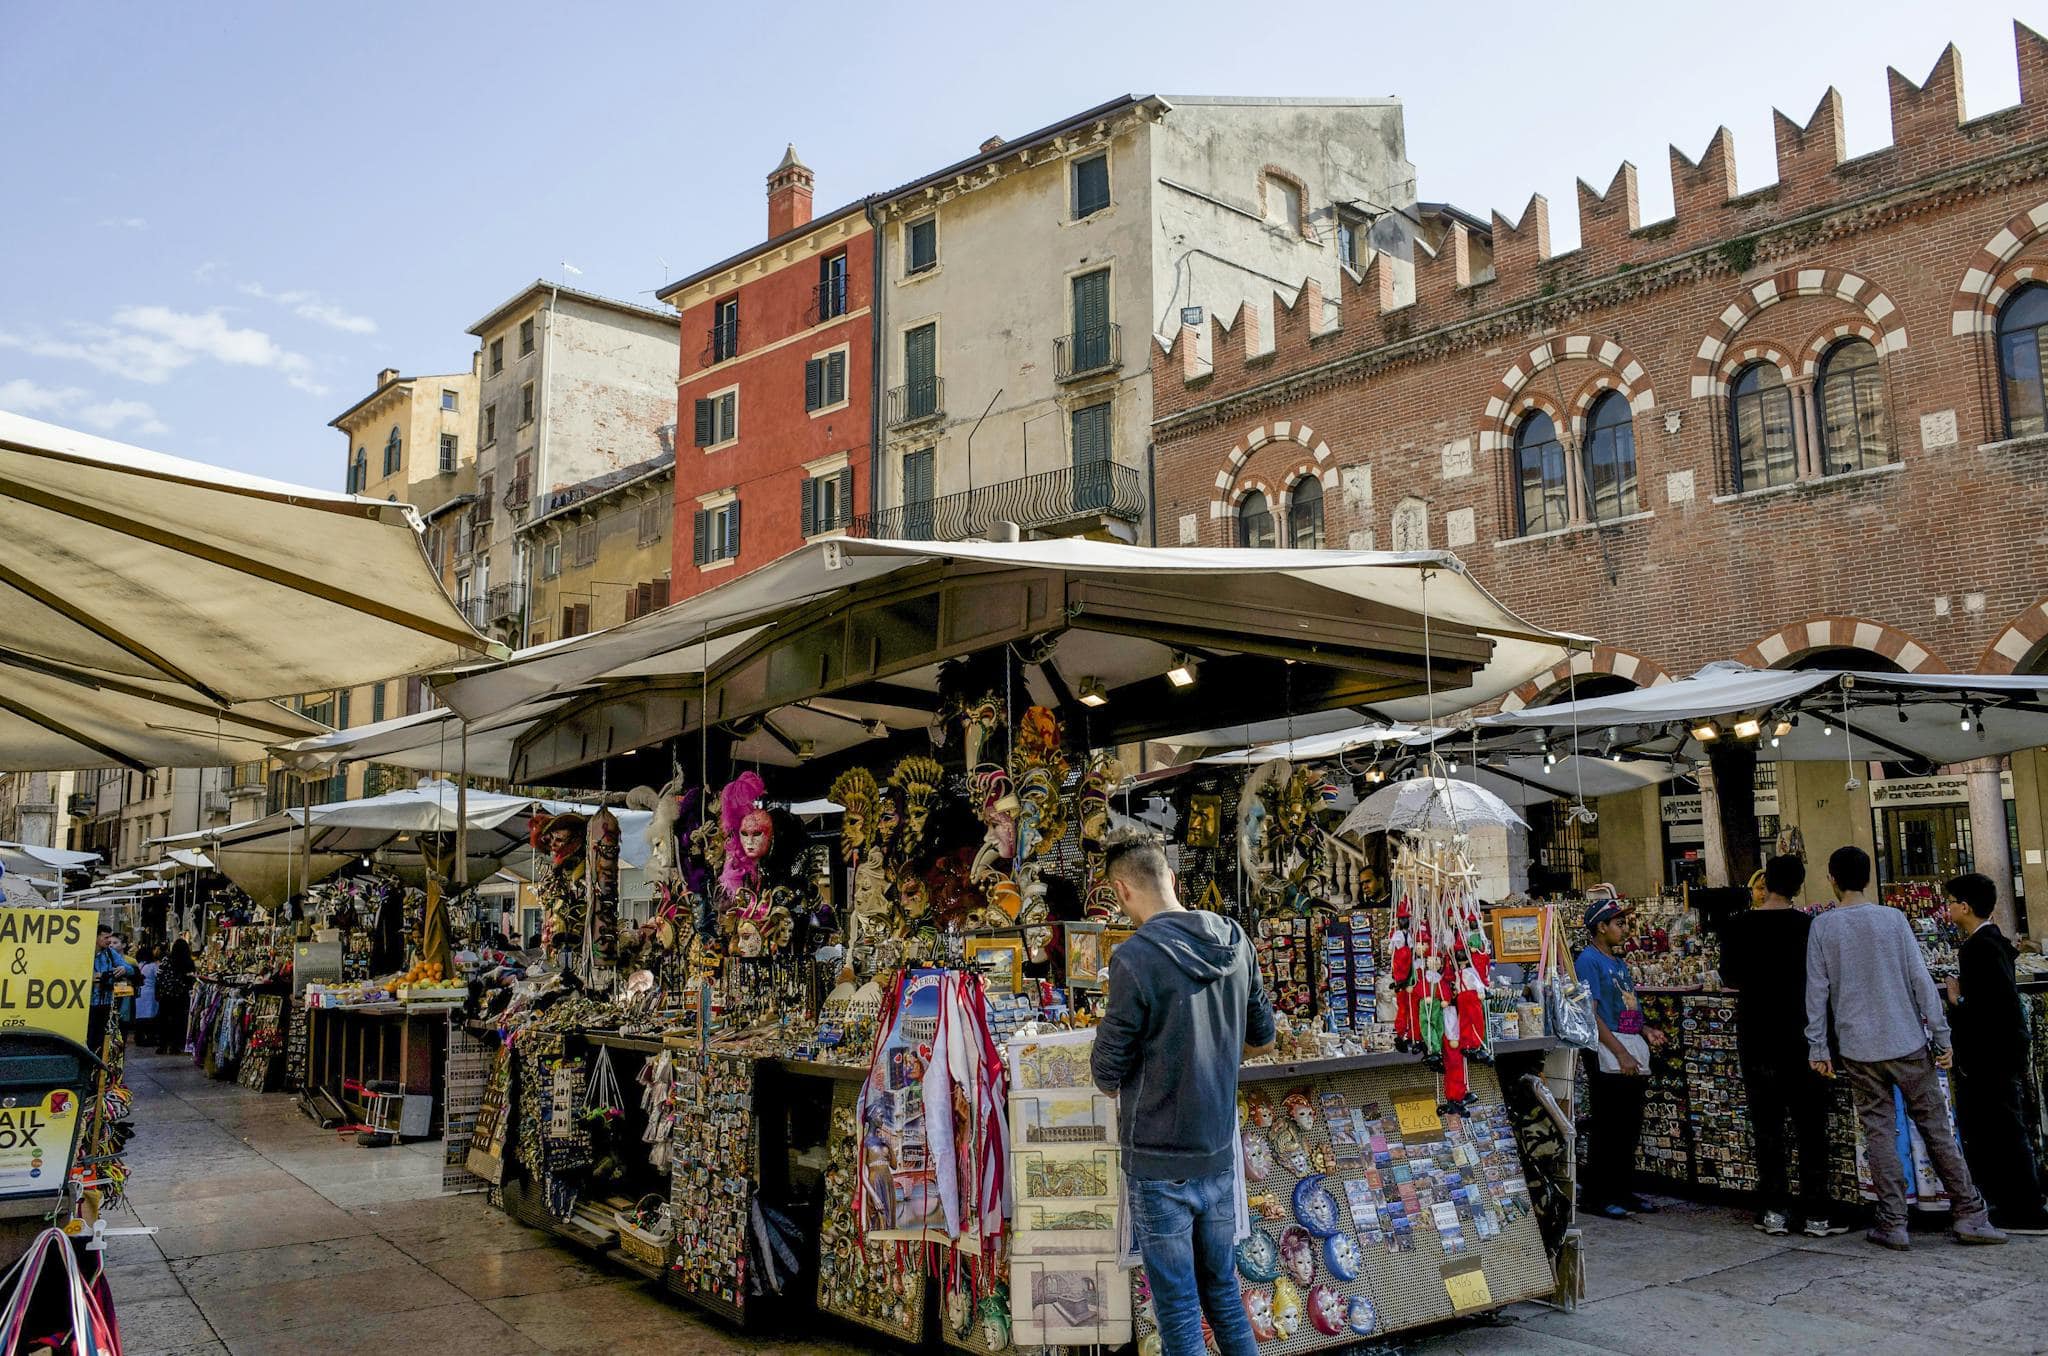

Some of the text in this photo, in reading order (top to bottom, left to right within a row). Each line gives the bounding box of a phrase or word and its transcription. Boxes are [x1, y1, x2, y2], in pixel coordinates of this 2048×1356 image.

[1888, 783, 1934, 792] BANCA
[1905, 789, 1961, 798] VERONA
[0, 913, 82, 945] AMPS
[11, 947, 28, 975] &
[913, 976, 940, 989] VERON
[0, 979, 87, 1009] L BOX
[2, 1019, 26, 1028] GPS
[0, 1110, 45, 1129] AIL
[0, 1128, 38, 1149] OX
